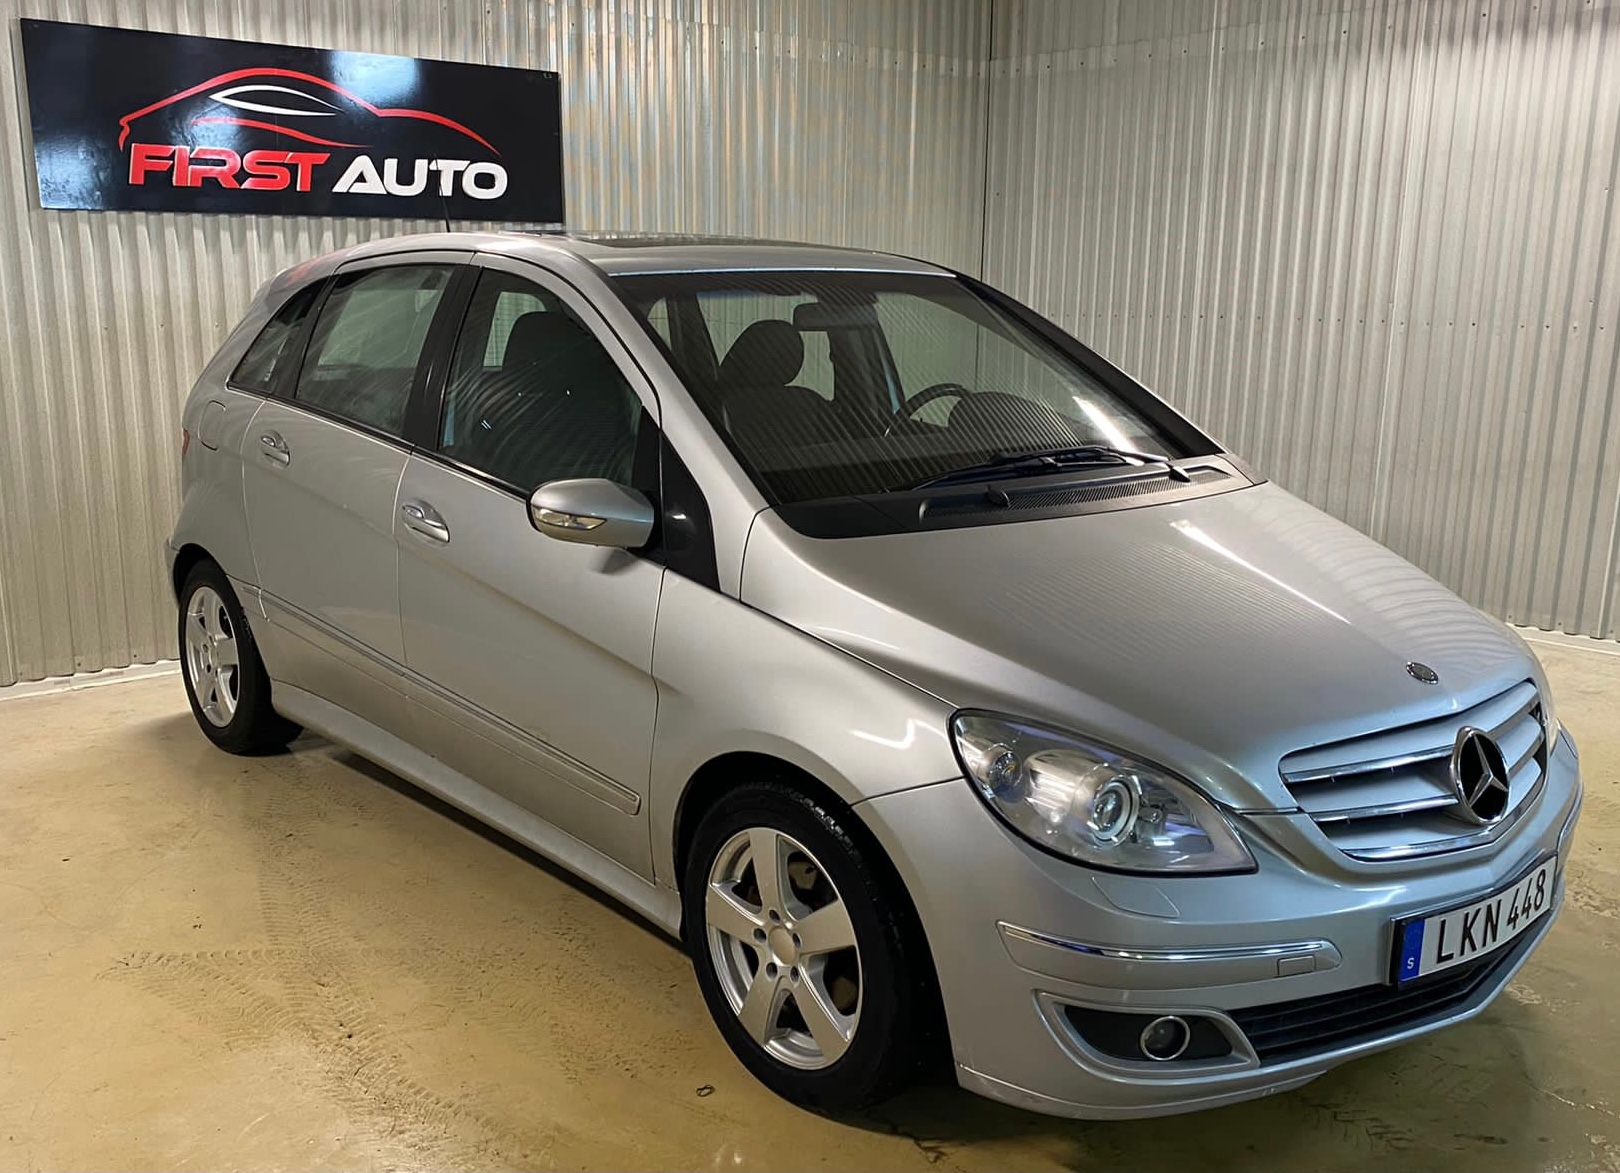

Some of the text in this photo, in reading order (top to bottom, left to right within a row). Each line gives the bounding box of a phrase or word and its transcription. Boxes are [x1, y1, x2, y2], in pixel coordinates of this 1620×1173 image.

[128, 143, 508, 199] FIRST AUTO
[1436, 869, 1546, 964] LKN 448
[1406, 957, 1415, 969] S
